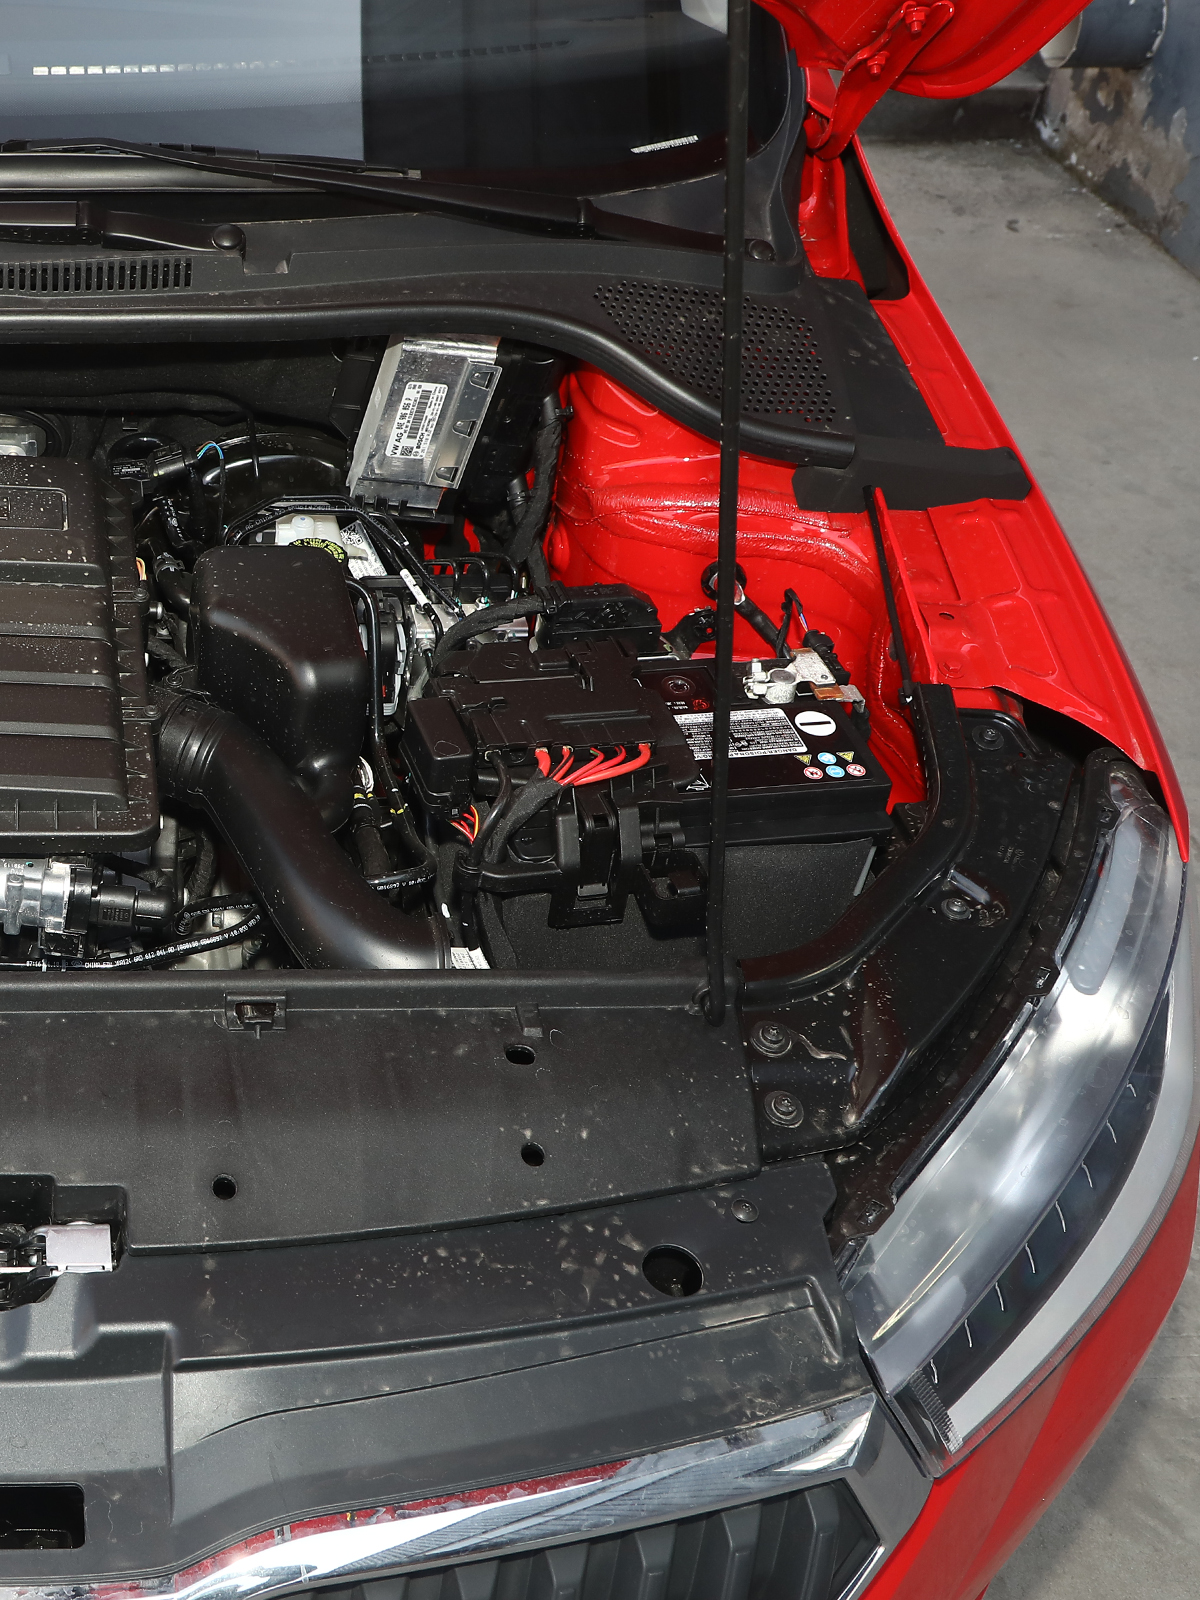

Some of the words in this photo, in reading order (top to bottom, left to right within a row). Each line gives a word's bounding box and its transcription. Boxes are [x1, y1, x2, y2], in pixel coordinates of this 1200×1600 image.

[390, 444, 400, 456] VW
[395, 432, 404, 444] AG
[415, 432, 425, 450] BOSCH
